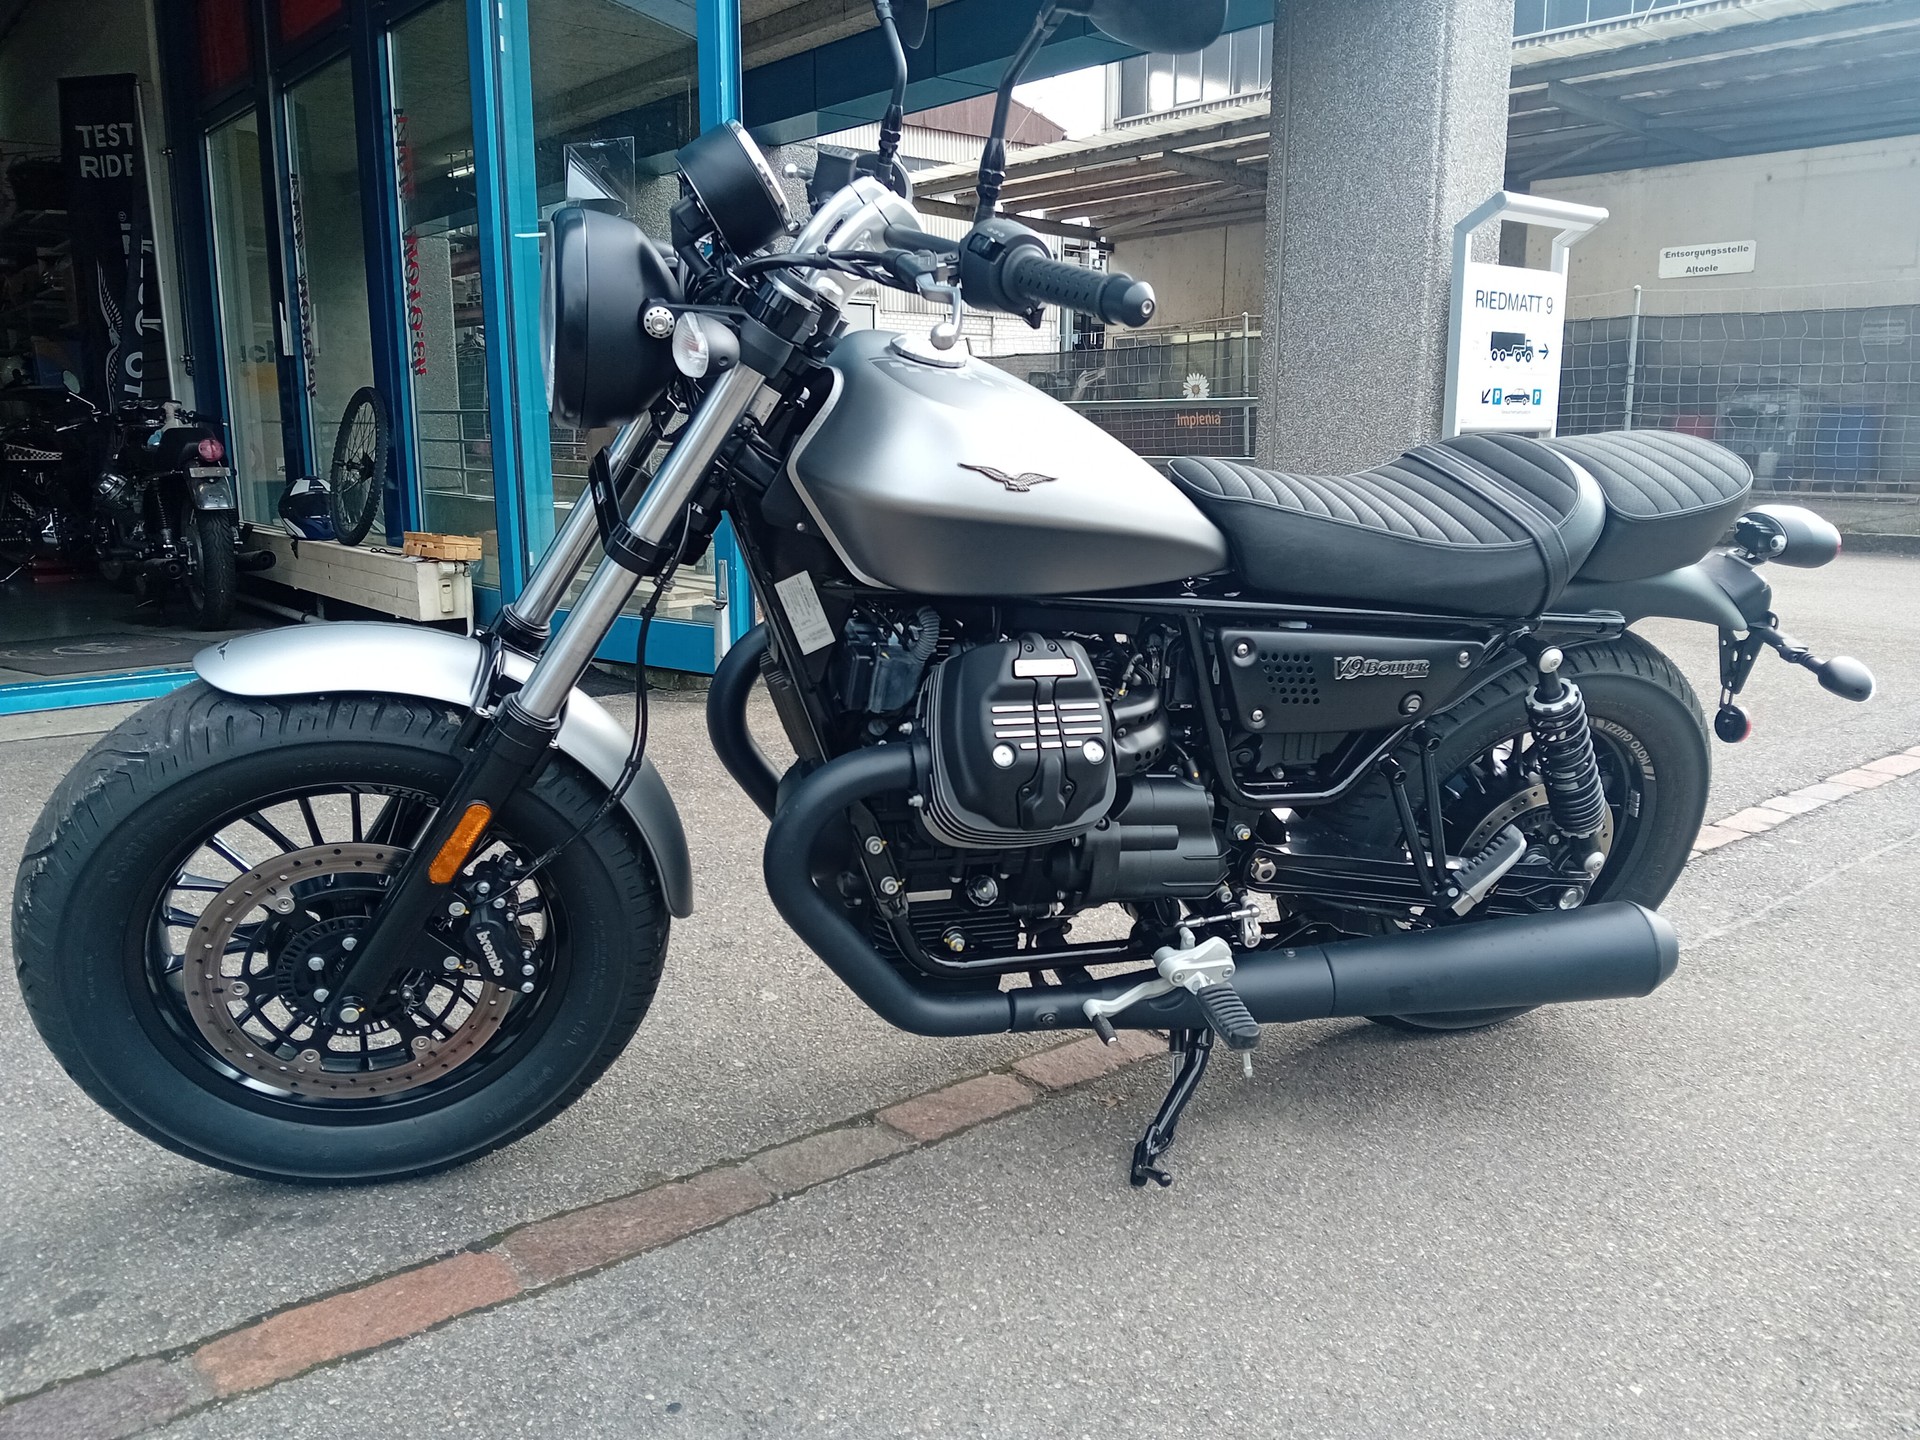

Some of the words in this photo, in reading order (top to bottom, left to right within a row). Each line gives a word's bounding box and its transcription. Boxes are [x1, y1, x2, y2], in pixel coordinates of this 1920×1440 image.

[75, 122, 133, 149] TEST
[79, 153, 133, 179] RIDE
[1665, 245, 1749, 259] Entsorgungsstelle
[1685, 264, 1719, 275] Altoele
[1475, 289, 1543, 313] RIEDMATT
[1546, 296, 1554, 315] 9
[1176, 411, 1222, 429] Implenia
[1333, 655, 1365, 680] V9
[1603, 720, 1634, 743] GUZZI
[1629, 740, 1652, 767] MOTO
[380, 786, 440, 806] GUZZI
[475, 930, 505, 977] brembo
